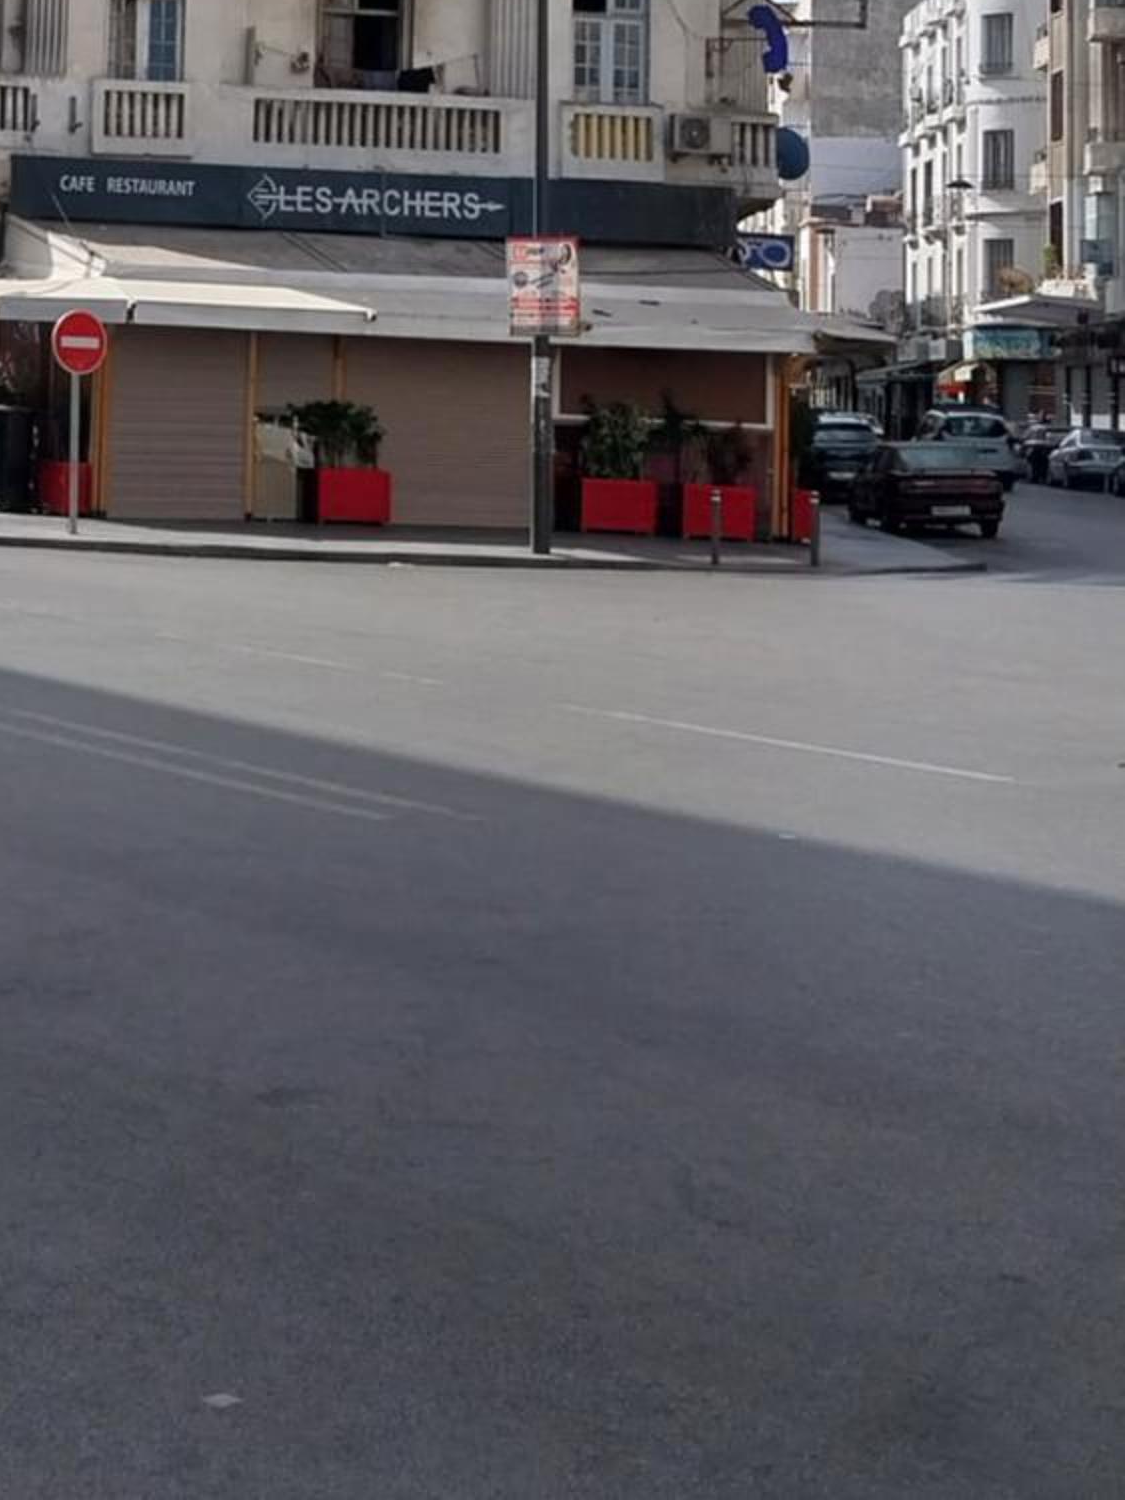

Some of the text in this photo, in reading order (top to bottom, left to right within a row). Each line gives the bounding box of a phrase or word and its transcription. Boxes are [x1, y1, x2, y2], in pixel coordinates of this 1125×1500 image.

[60, 175, 195, 196] CAFE RESTAURANT
[278, 184, 481, 220] LES ARCHERS
